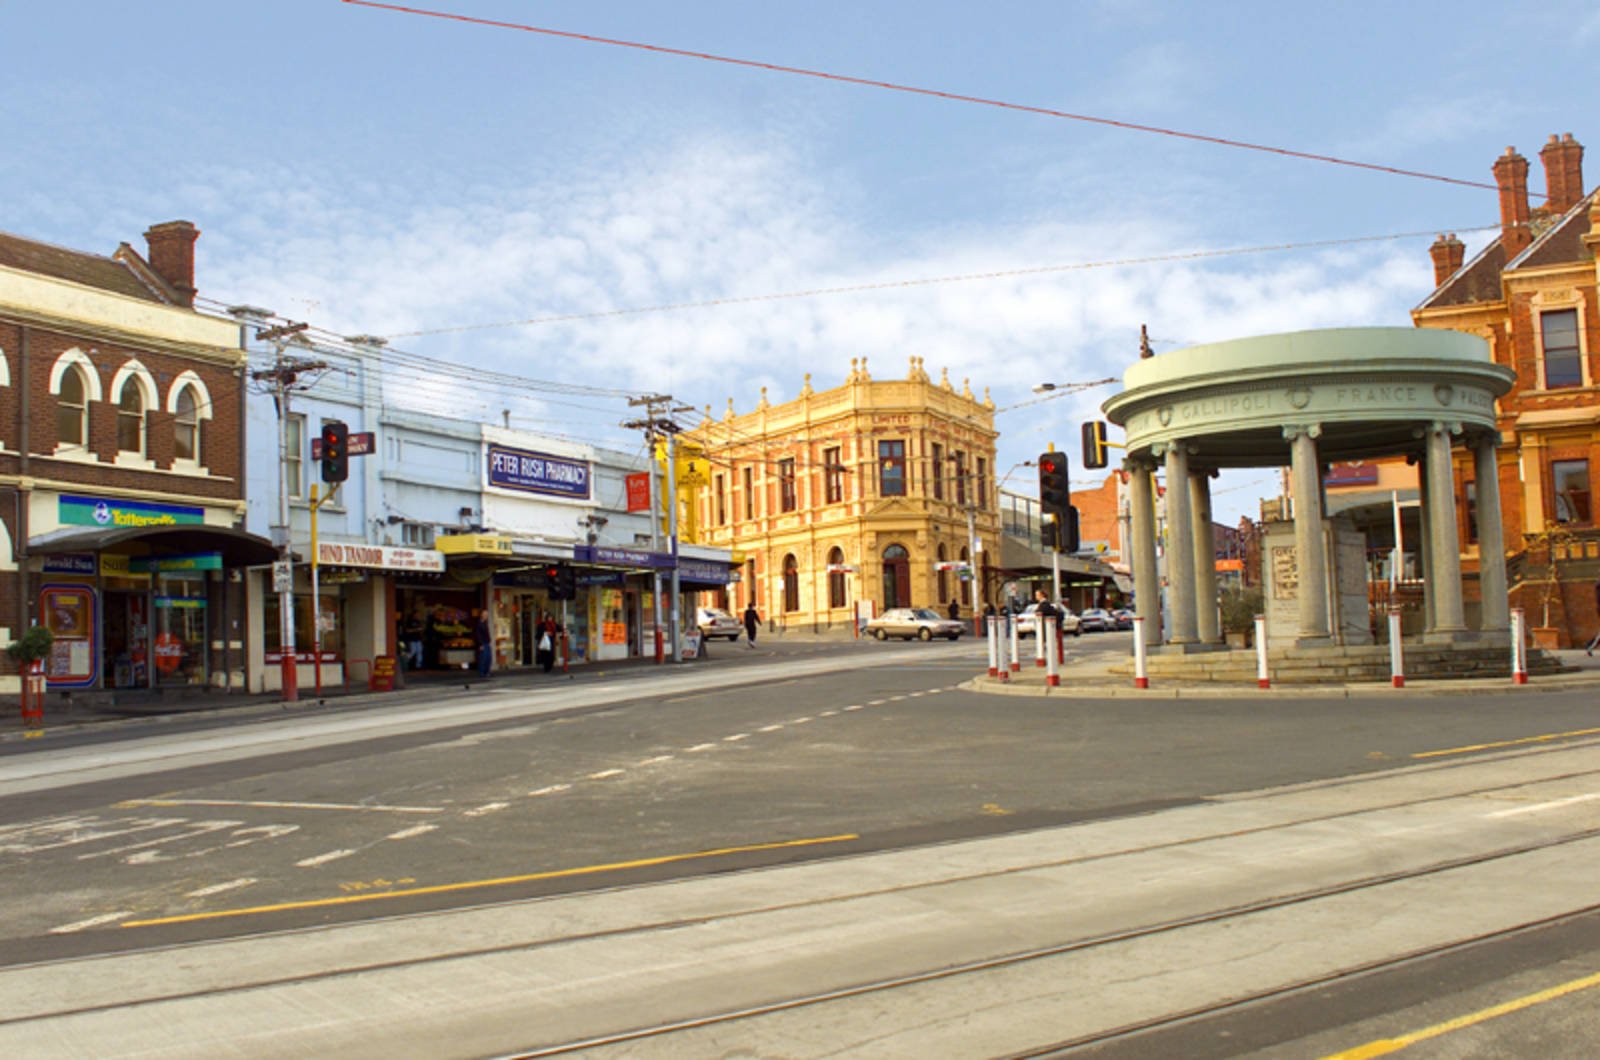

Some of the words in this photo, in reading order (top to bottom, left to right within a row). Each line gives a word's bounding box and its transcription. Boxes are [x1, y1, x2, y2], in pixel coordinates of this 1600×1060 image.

[1335, 386, 1417, 404] FRANCE
[1181, 394, 1272, 419] GALLIPOLI
[492, 452, 519, 475] PETER
[521, 457, 545, 479] RUSH
[545, 461, 586, 485] PHARMACY
[344, 546, 383, 565] TANDOOR
